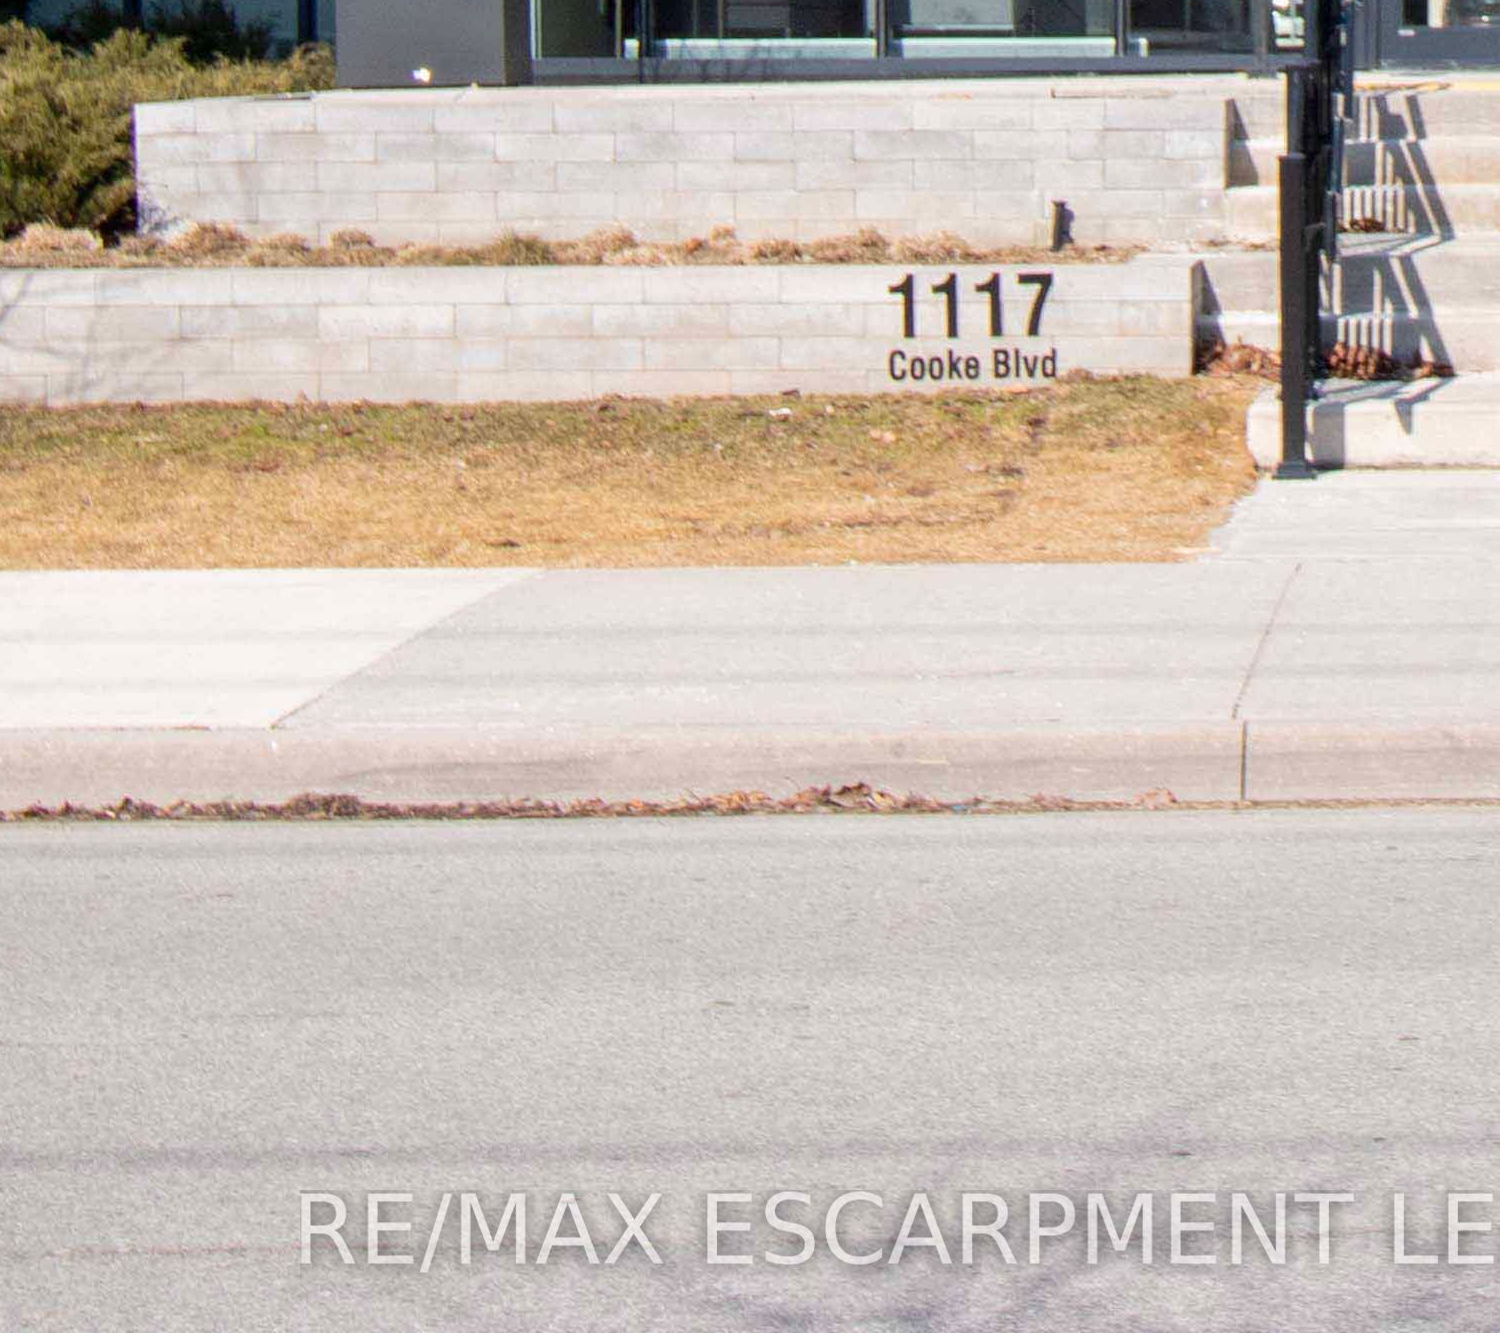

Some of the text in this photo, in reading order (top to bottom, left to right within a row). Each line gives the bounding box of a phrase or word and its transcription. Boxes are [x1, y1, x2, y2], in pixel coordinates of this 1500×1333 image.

[888, 272, 1053, 338] 1117
[889, 348, 1057, 380] Cooke Blvd
